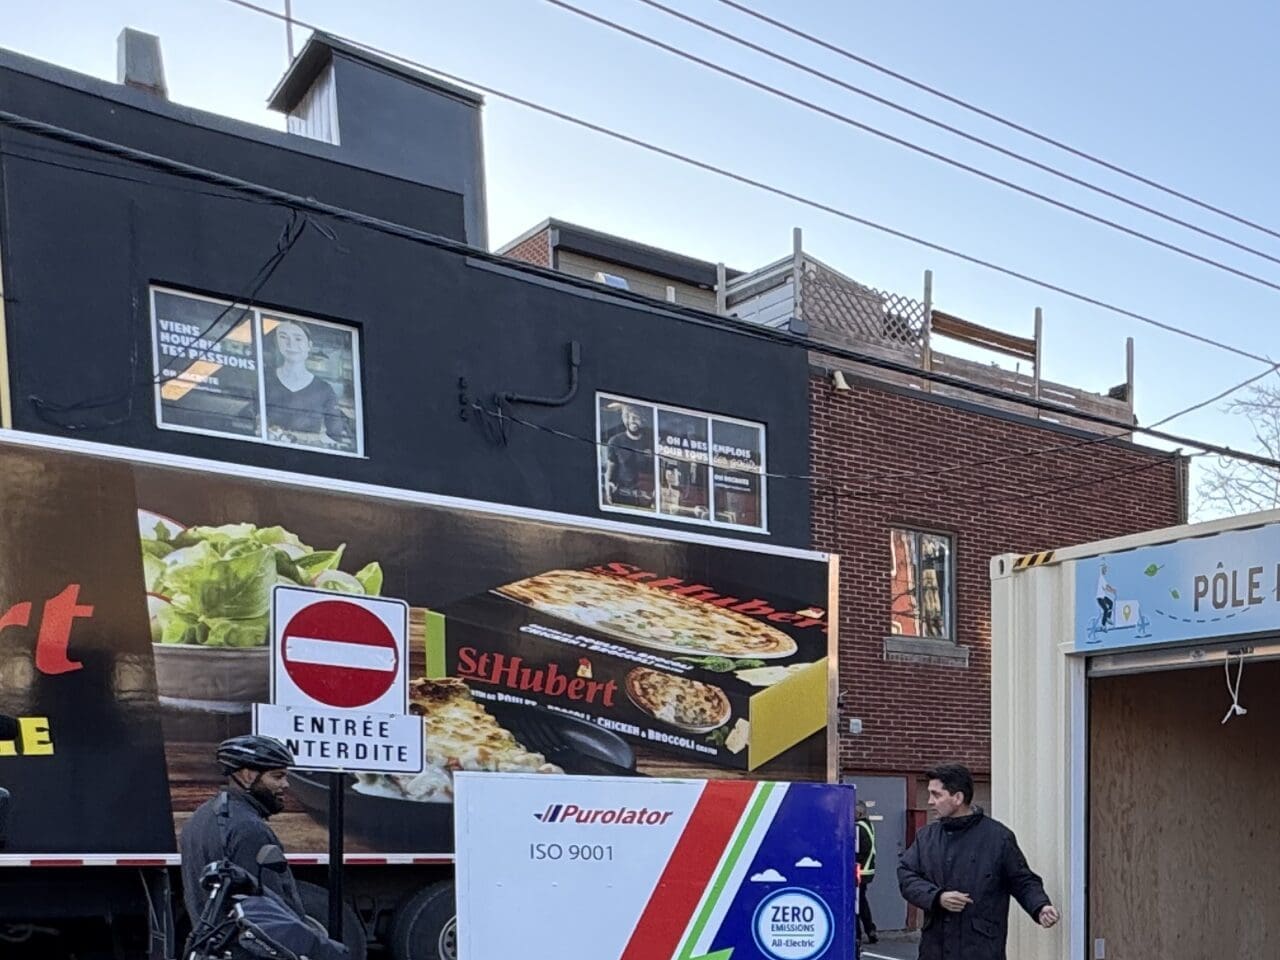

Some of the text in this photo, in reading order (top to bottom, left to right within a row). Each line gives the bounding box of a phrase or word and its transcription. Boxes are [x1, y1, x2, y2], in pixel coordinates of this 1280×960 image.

[160, 319, 200, 337] VIENS
[187, 349, 256, 370] PASSIONS
[666, 435, 681, 447] ON
[681, 438, 690, 449] A
[603, 562, 829, 634] StHuber
[1193, 561, 1264, 612] PÔLE
[457, 646, 618, 707] StHubert
[293, 714, 390, 739] ENTRÉE
[597, 716, 640, 737] CHICKEN
[647, 728, 695, 750] BROCCOLI
[286, 738, 409, 763] NTERDITE
[559, 804, 674, 827] Purolator
[530, 843, 615, 862] ISO 9001
[771, 905, 815, 923] ZERO
[771, 923, 815, 932] EMISSIONS
